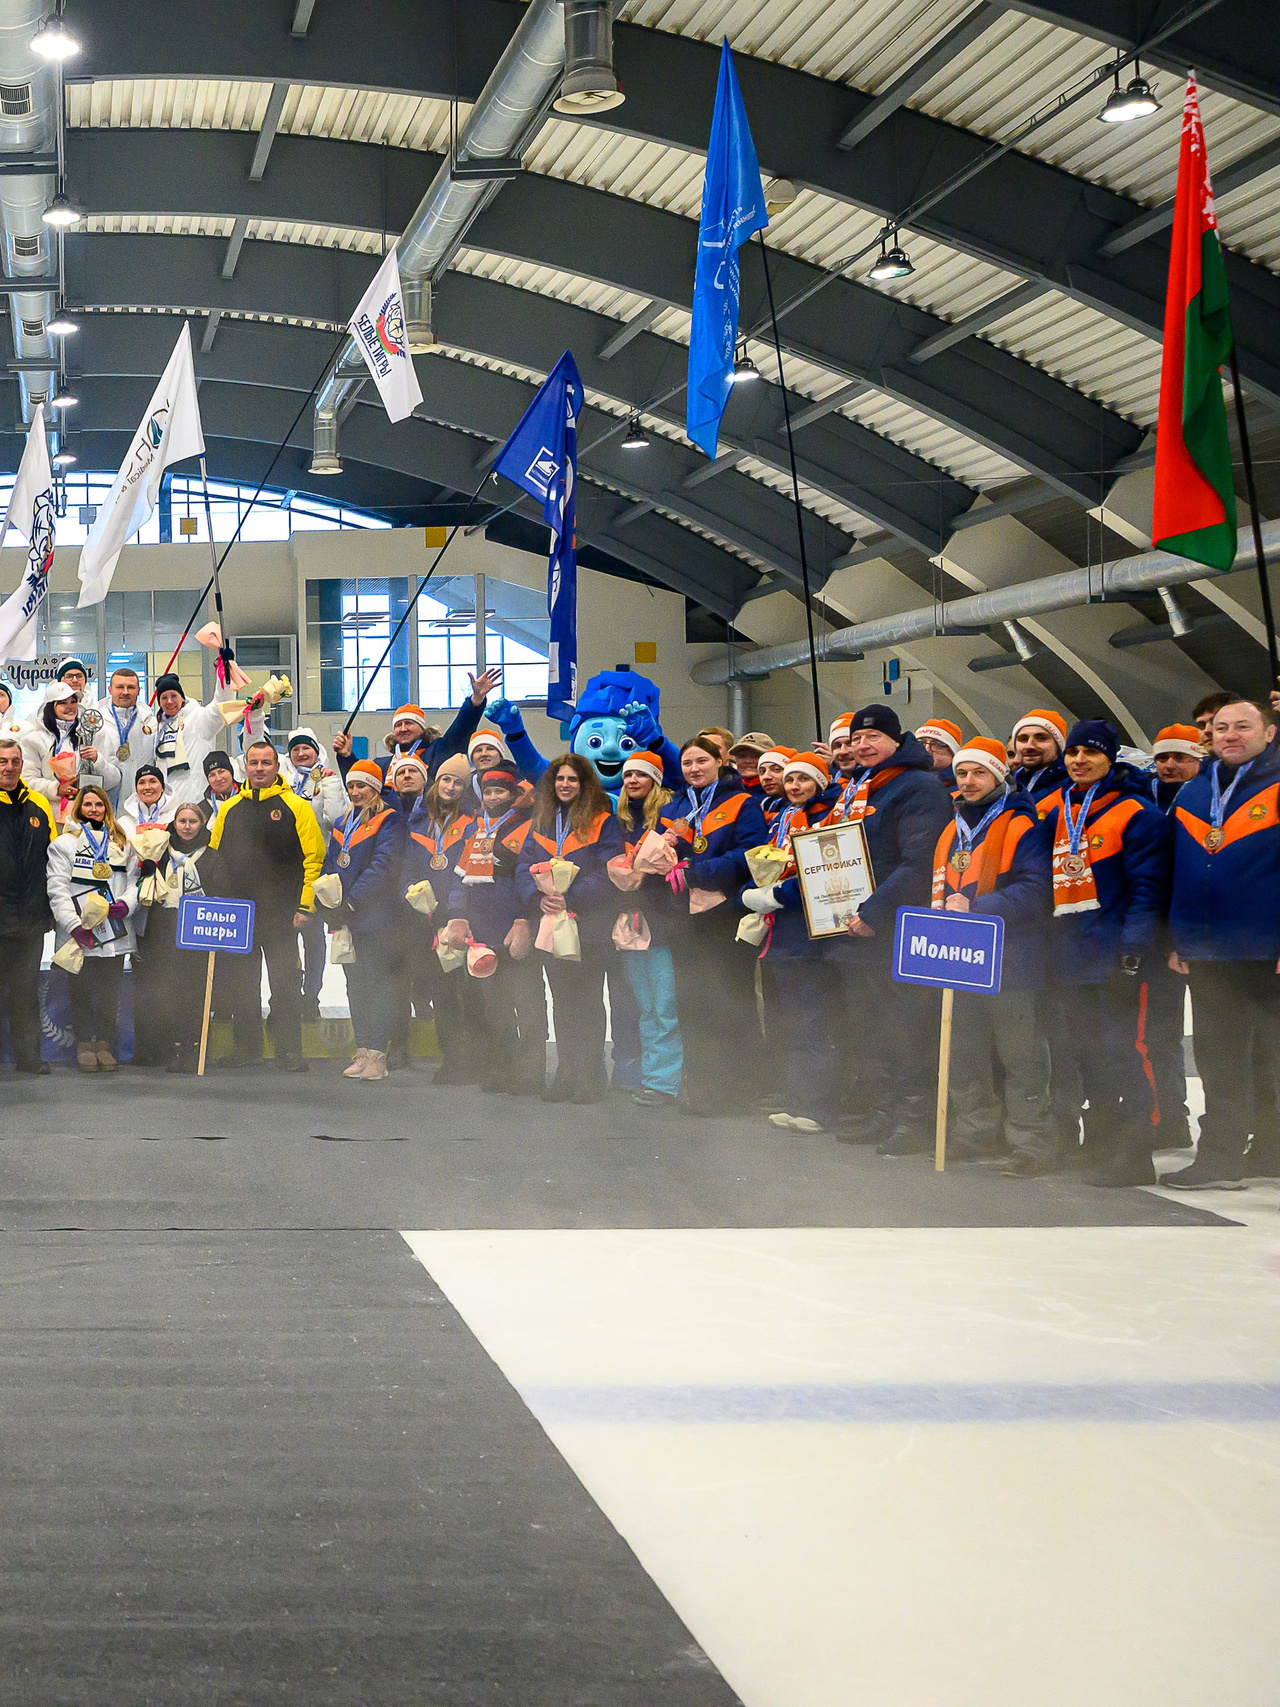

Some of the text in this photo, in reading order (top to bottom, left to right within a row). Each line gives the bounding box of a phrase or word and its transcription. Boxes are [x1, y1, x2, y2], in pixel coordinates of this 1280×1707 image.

[372, 346, 392, 377] ТИГРЫ
[804, 857, 862, 875] СЕРТИФИКАТ
[196, 907, 237, 923] Белые
[193, 925, 237, 941] тигры
[910, 935, 985, 965] Молния
